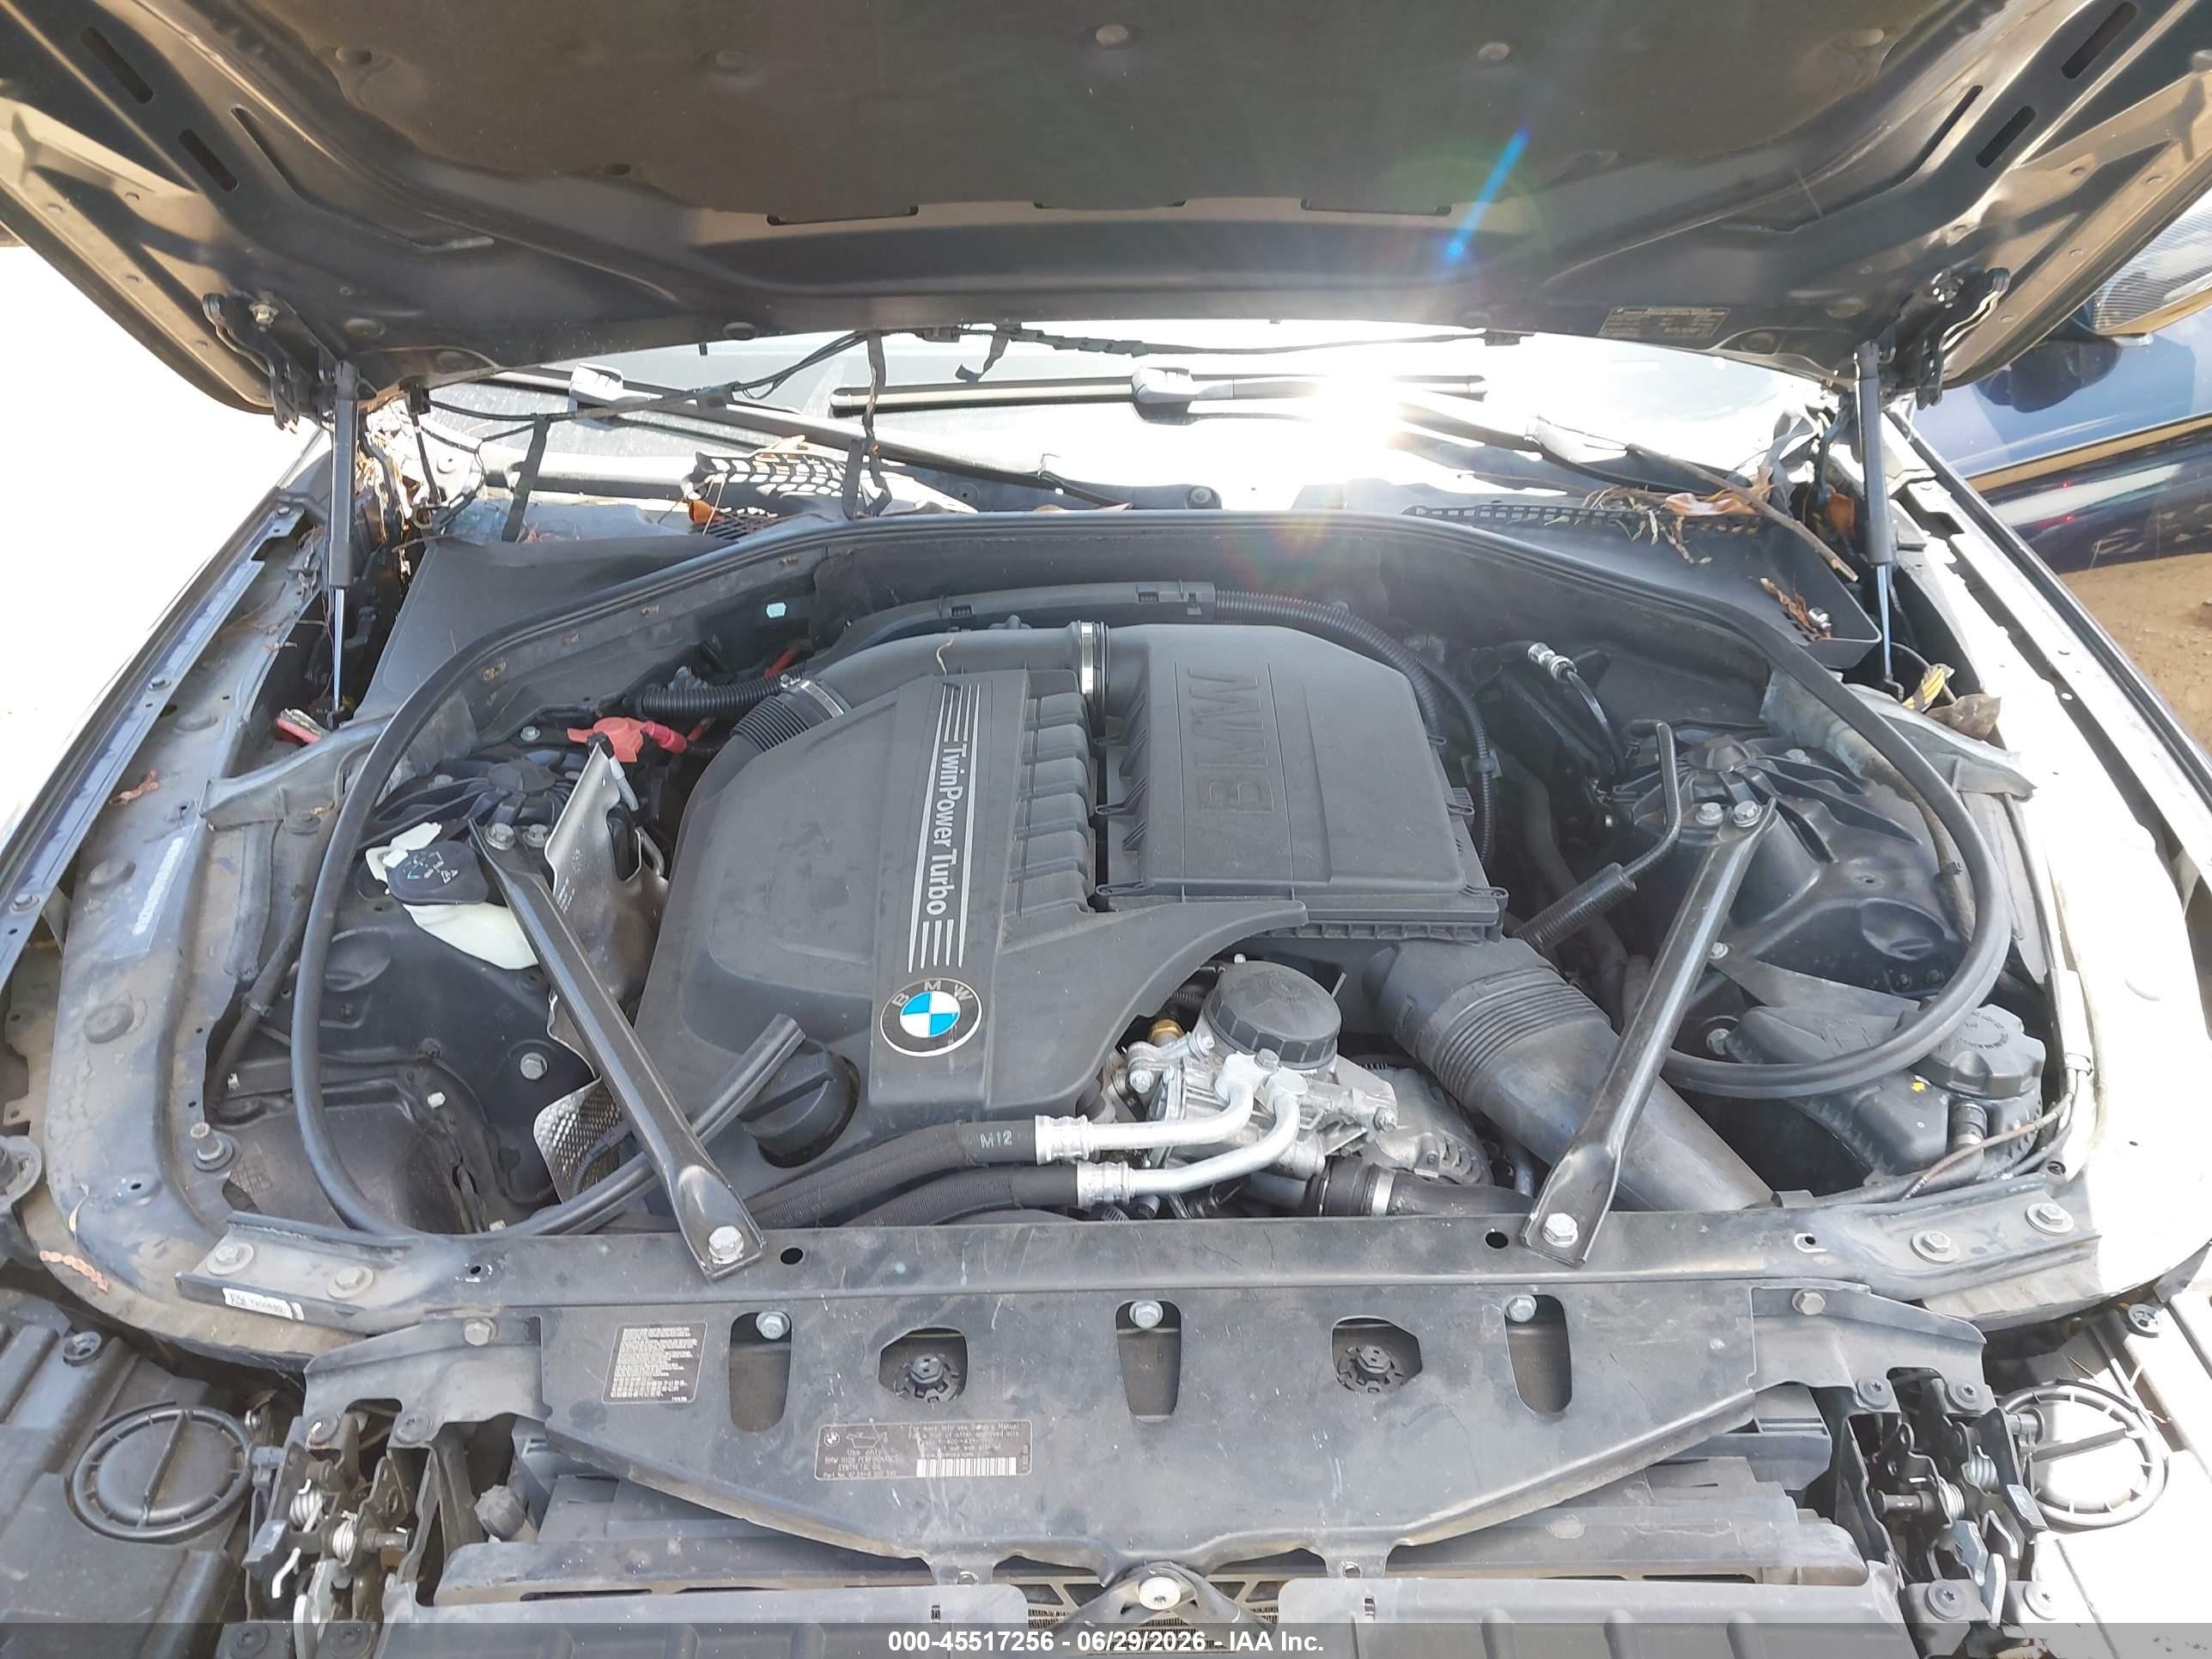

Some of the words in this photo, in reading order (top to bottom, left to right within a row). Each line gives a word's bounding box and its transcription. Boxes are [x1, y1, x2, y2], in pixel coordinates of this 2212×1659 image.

[1188, 665, 1275, 812] BMW
[934, 743, 968, 847] TwinPower
[926, 848, 957, 915] Turbo
[891, 980, 974, 1007] BMW
[980, 1130, 1013, 1149] M12
